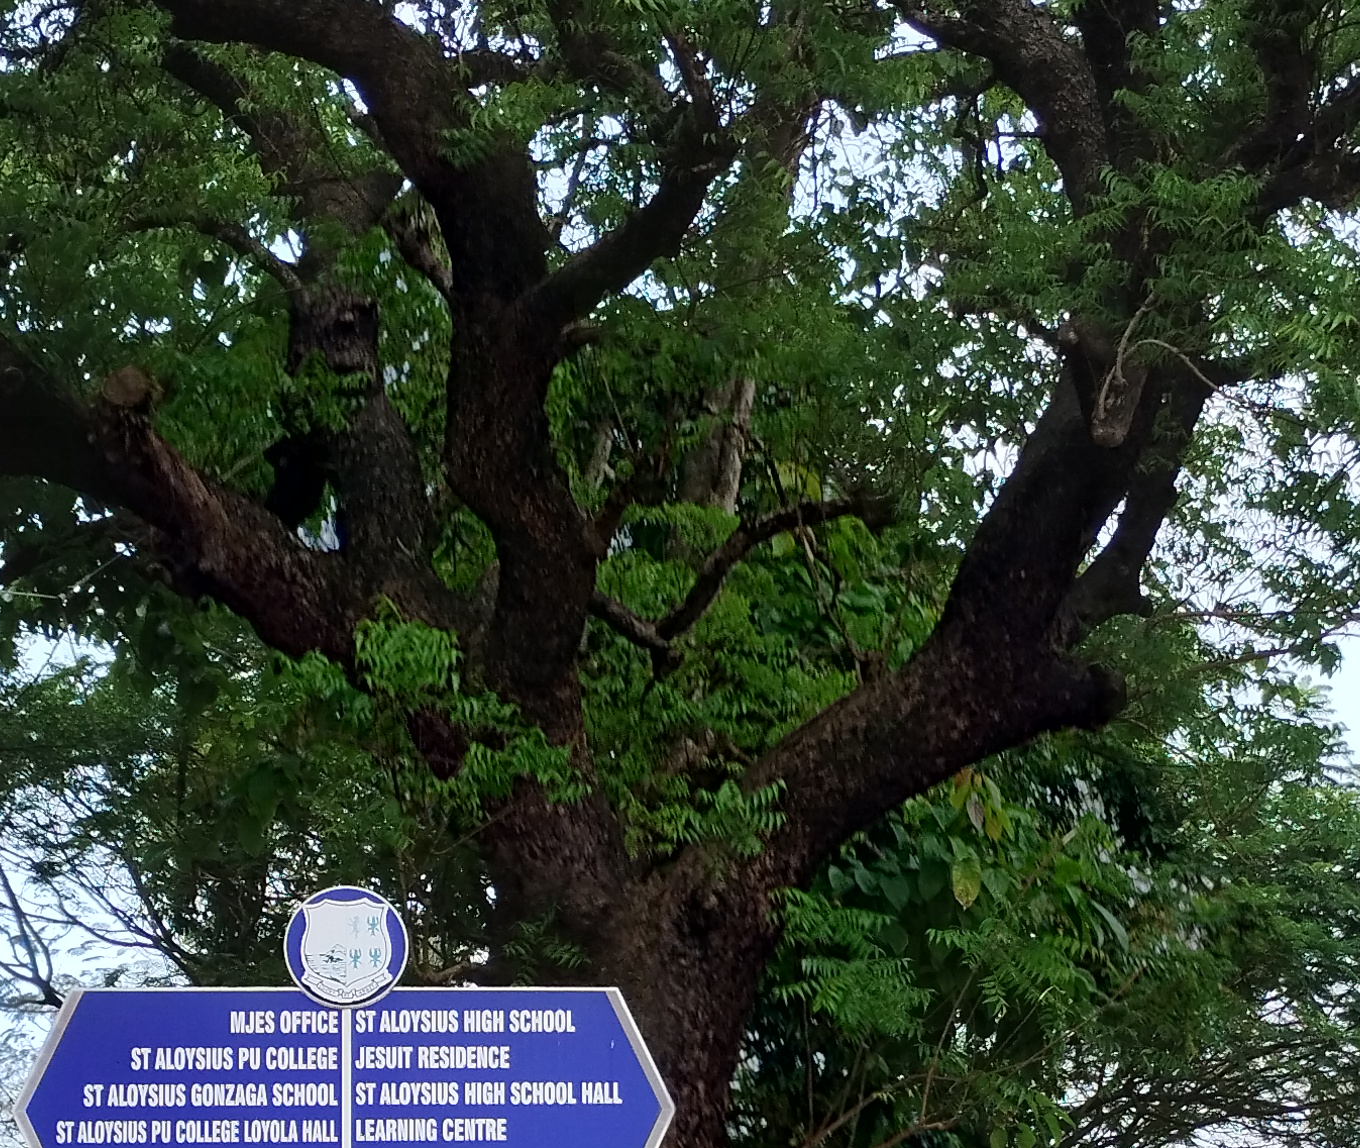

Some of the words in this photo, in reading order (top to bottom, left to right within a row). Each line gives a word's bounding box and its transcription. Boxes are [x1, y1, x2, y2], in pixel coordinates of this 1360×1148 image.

[230, 1010, 275, 1034] MJES
[280, 1010, 339, 1034] OFFICE
[355, 1009, 377, 1033] ST
[379, 1009, 459, 1033] ALOYSIUS
[463, 1009, 505, 1033] HIGH
[509, 1009, 576, 1033] SCHOOL
[130, 1047, 152, 1070] ST
[154, 1047, 234, 1070] ALOYSIUS
[238, 1047, 261, 1070] PU
[265, 1046, 338, 1070] COLLEGE
[354, 1046, 414, 1069] JESUIT
[418, 1045, 510, 1069] RESIDENCE
[83, 1083, 105, 1107] ST
[107, 1083, 186, 1107] ALOYSIUS
[190, 1083, 268, 1107] GONZAGA
[271, 1082, 339, 1107] SCHOOL
[355, 1082, 377, 1105] ST
[379, 1081, 459, 1105] ALOYSIUS
[464, 1081, 506, 1105] HIGH
[510, 1081, 577, 1105] SCHOOL
[581, 1081, 623, 1104] HALL
[55, 1120, 75, 1144] ST
[77, 1120, 148, 1144] ALOYSIUS
[151, 1120, 172, 1144] PU
[175, 1120, 240, 1143] COLLEGE
[243, 1119, 299, 1143] LOYOLA
[302, 1119, 339, 1143] HALL
[355, 1118, 438, 1142] LEARNING
[442, 1118, 507, 1141] CENTRE
